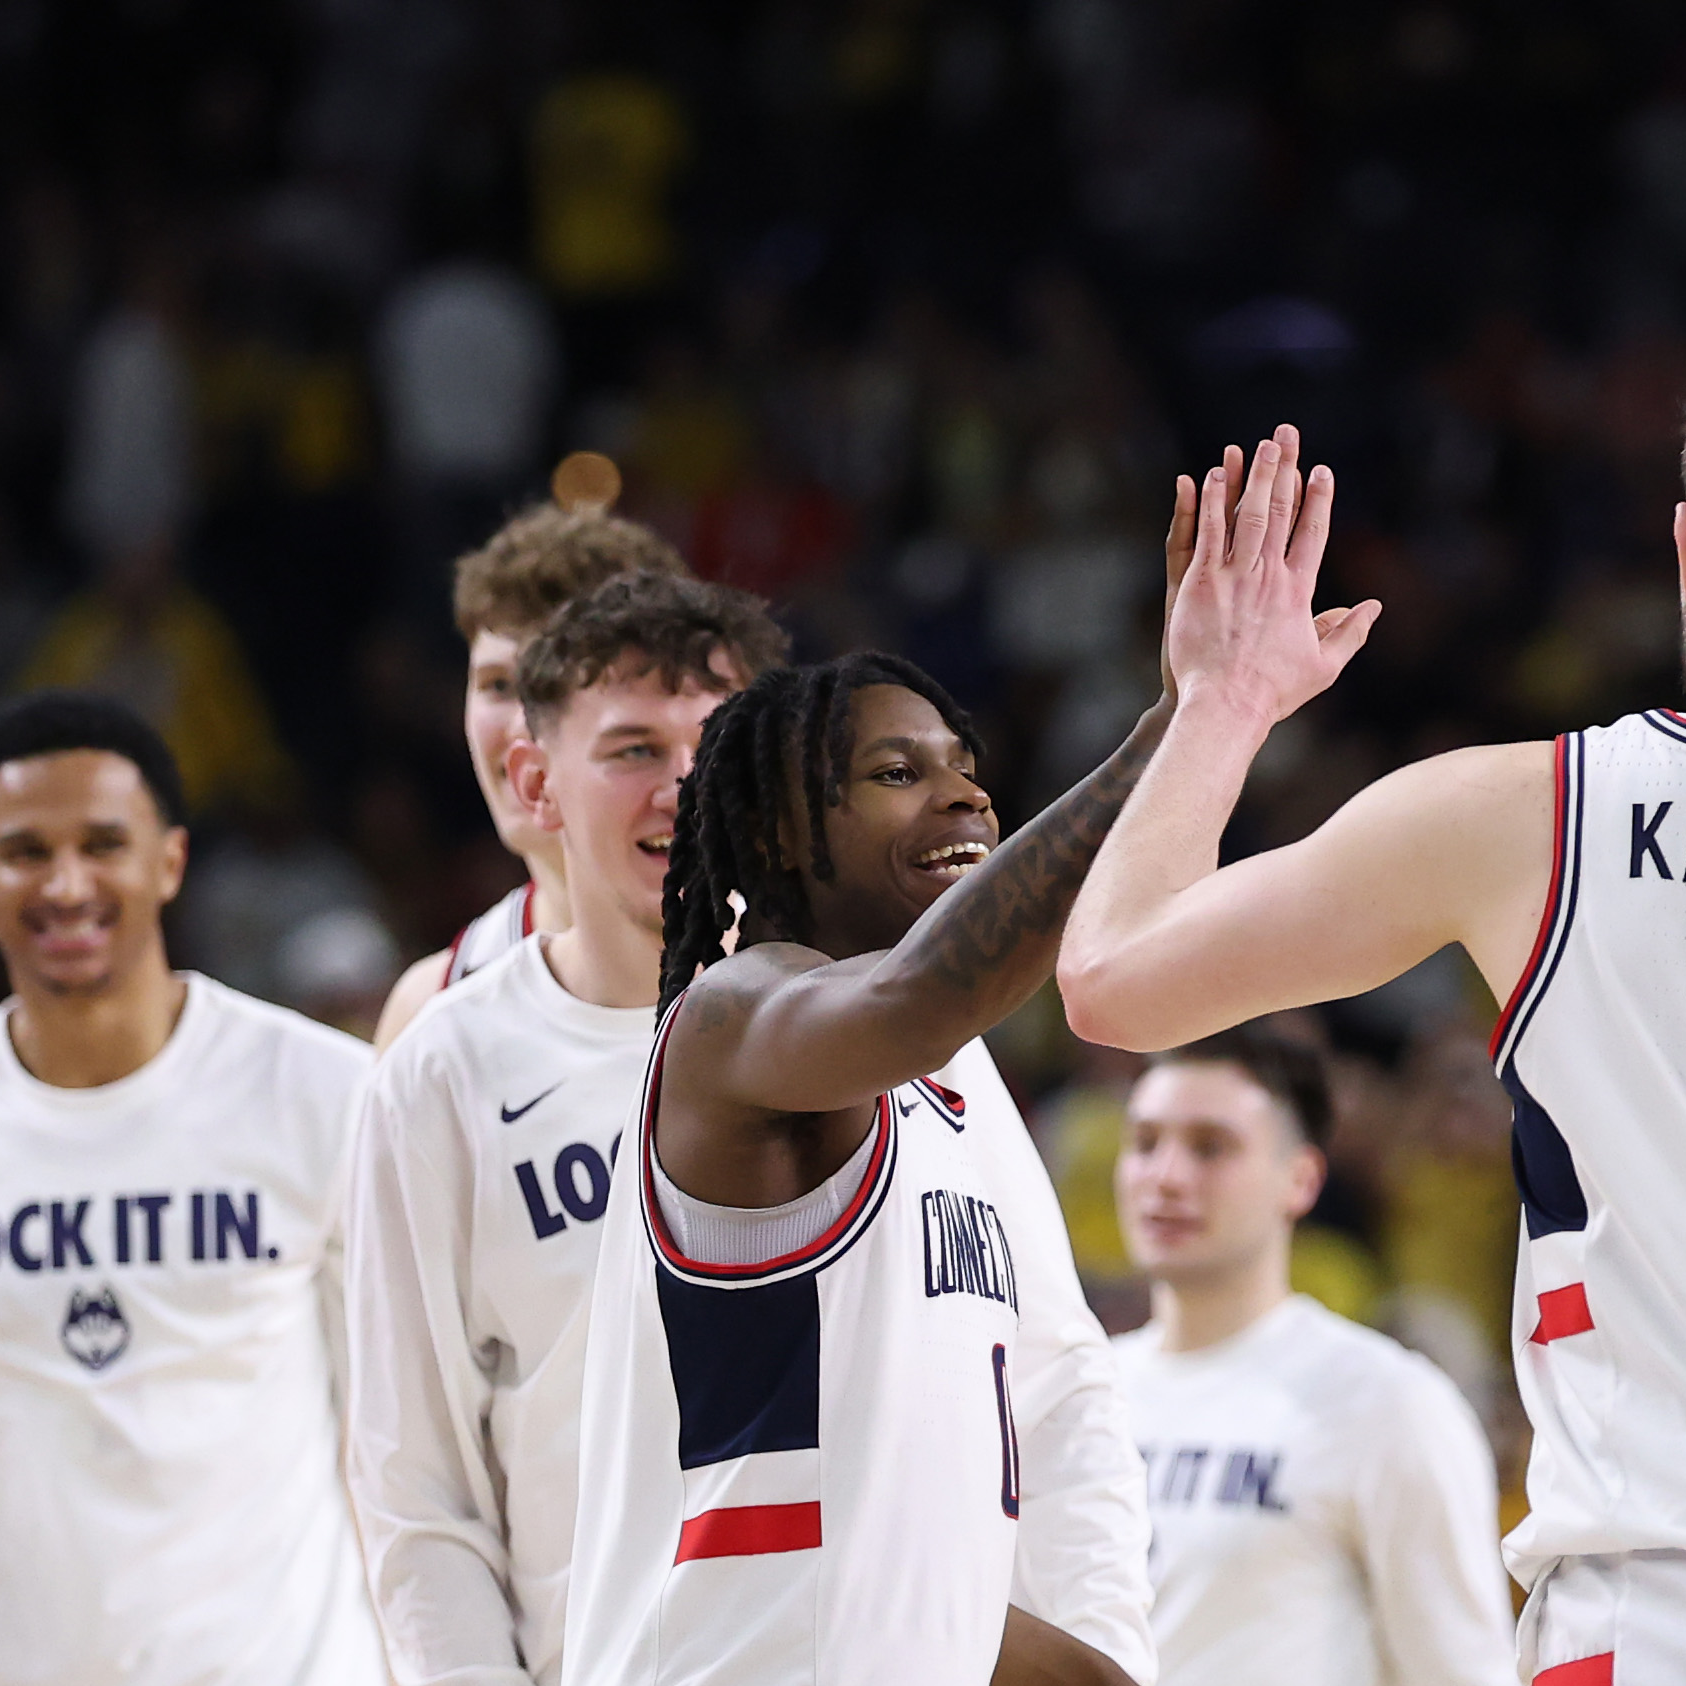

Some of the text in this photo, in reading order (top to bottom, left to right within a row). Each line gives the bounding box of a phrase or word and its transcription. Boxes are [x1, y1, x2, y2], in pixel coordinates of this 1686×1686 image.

[115, 1194, 171, 1264] IT
[190, 1191, 280, 1261] IN.
[514, 1130, 624, 1240] LO
